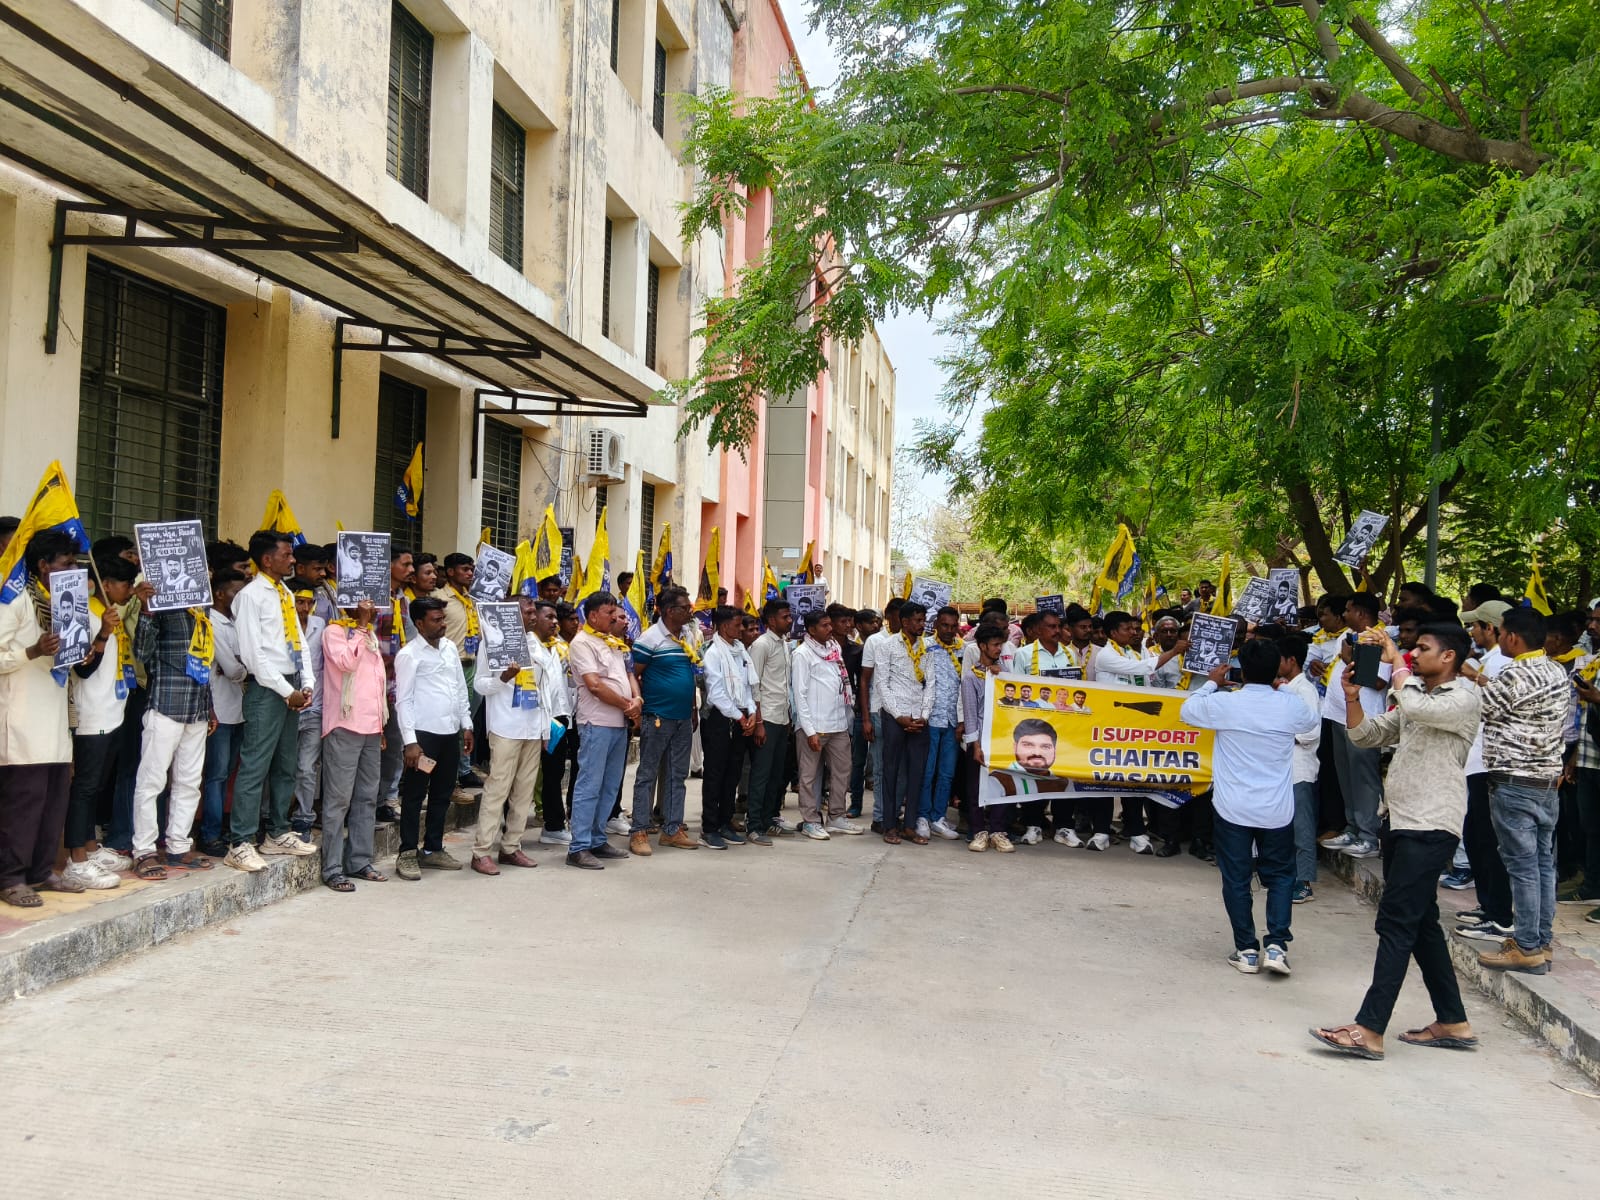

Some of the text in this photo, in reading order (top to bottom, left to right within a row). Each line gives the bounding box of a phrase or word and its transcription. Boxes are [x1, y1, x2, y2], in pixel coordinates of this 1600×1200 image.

[1092, 727, 1200, 744] I SUPPORT
[1089, 748, 1200, 769] CHAITAR
